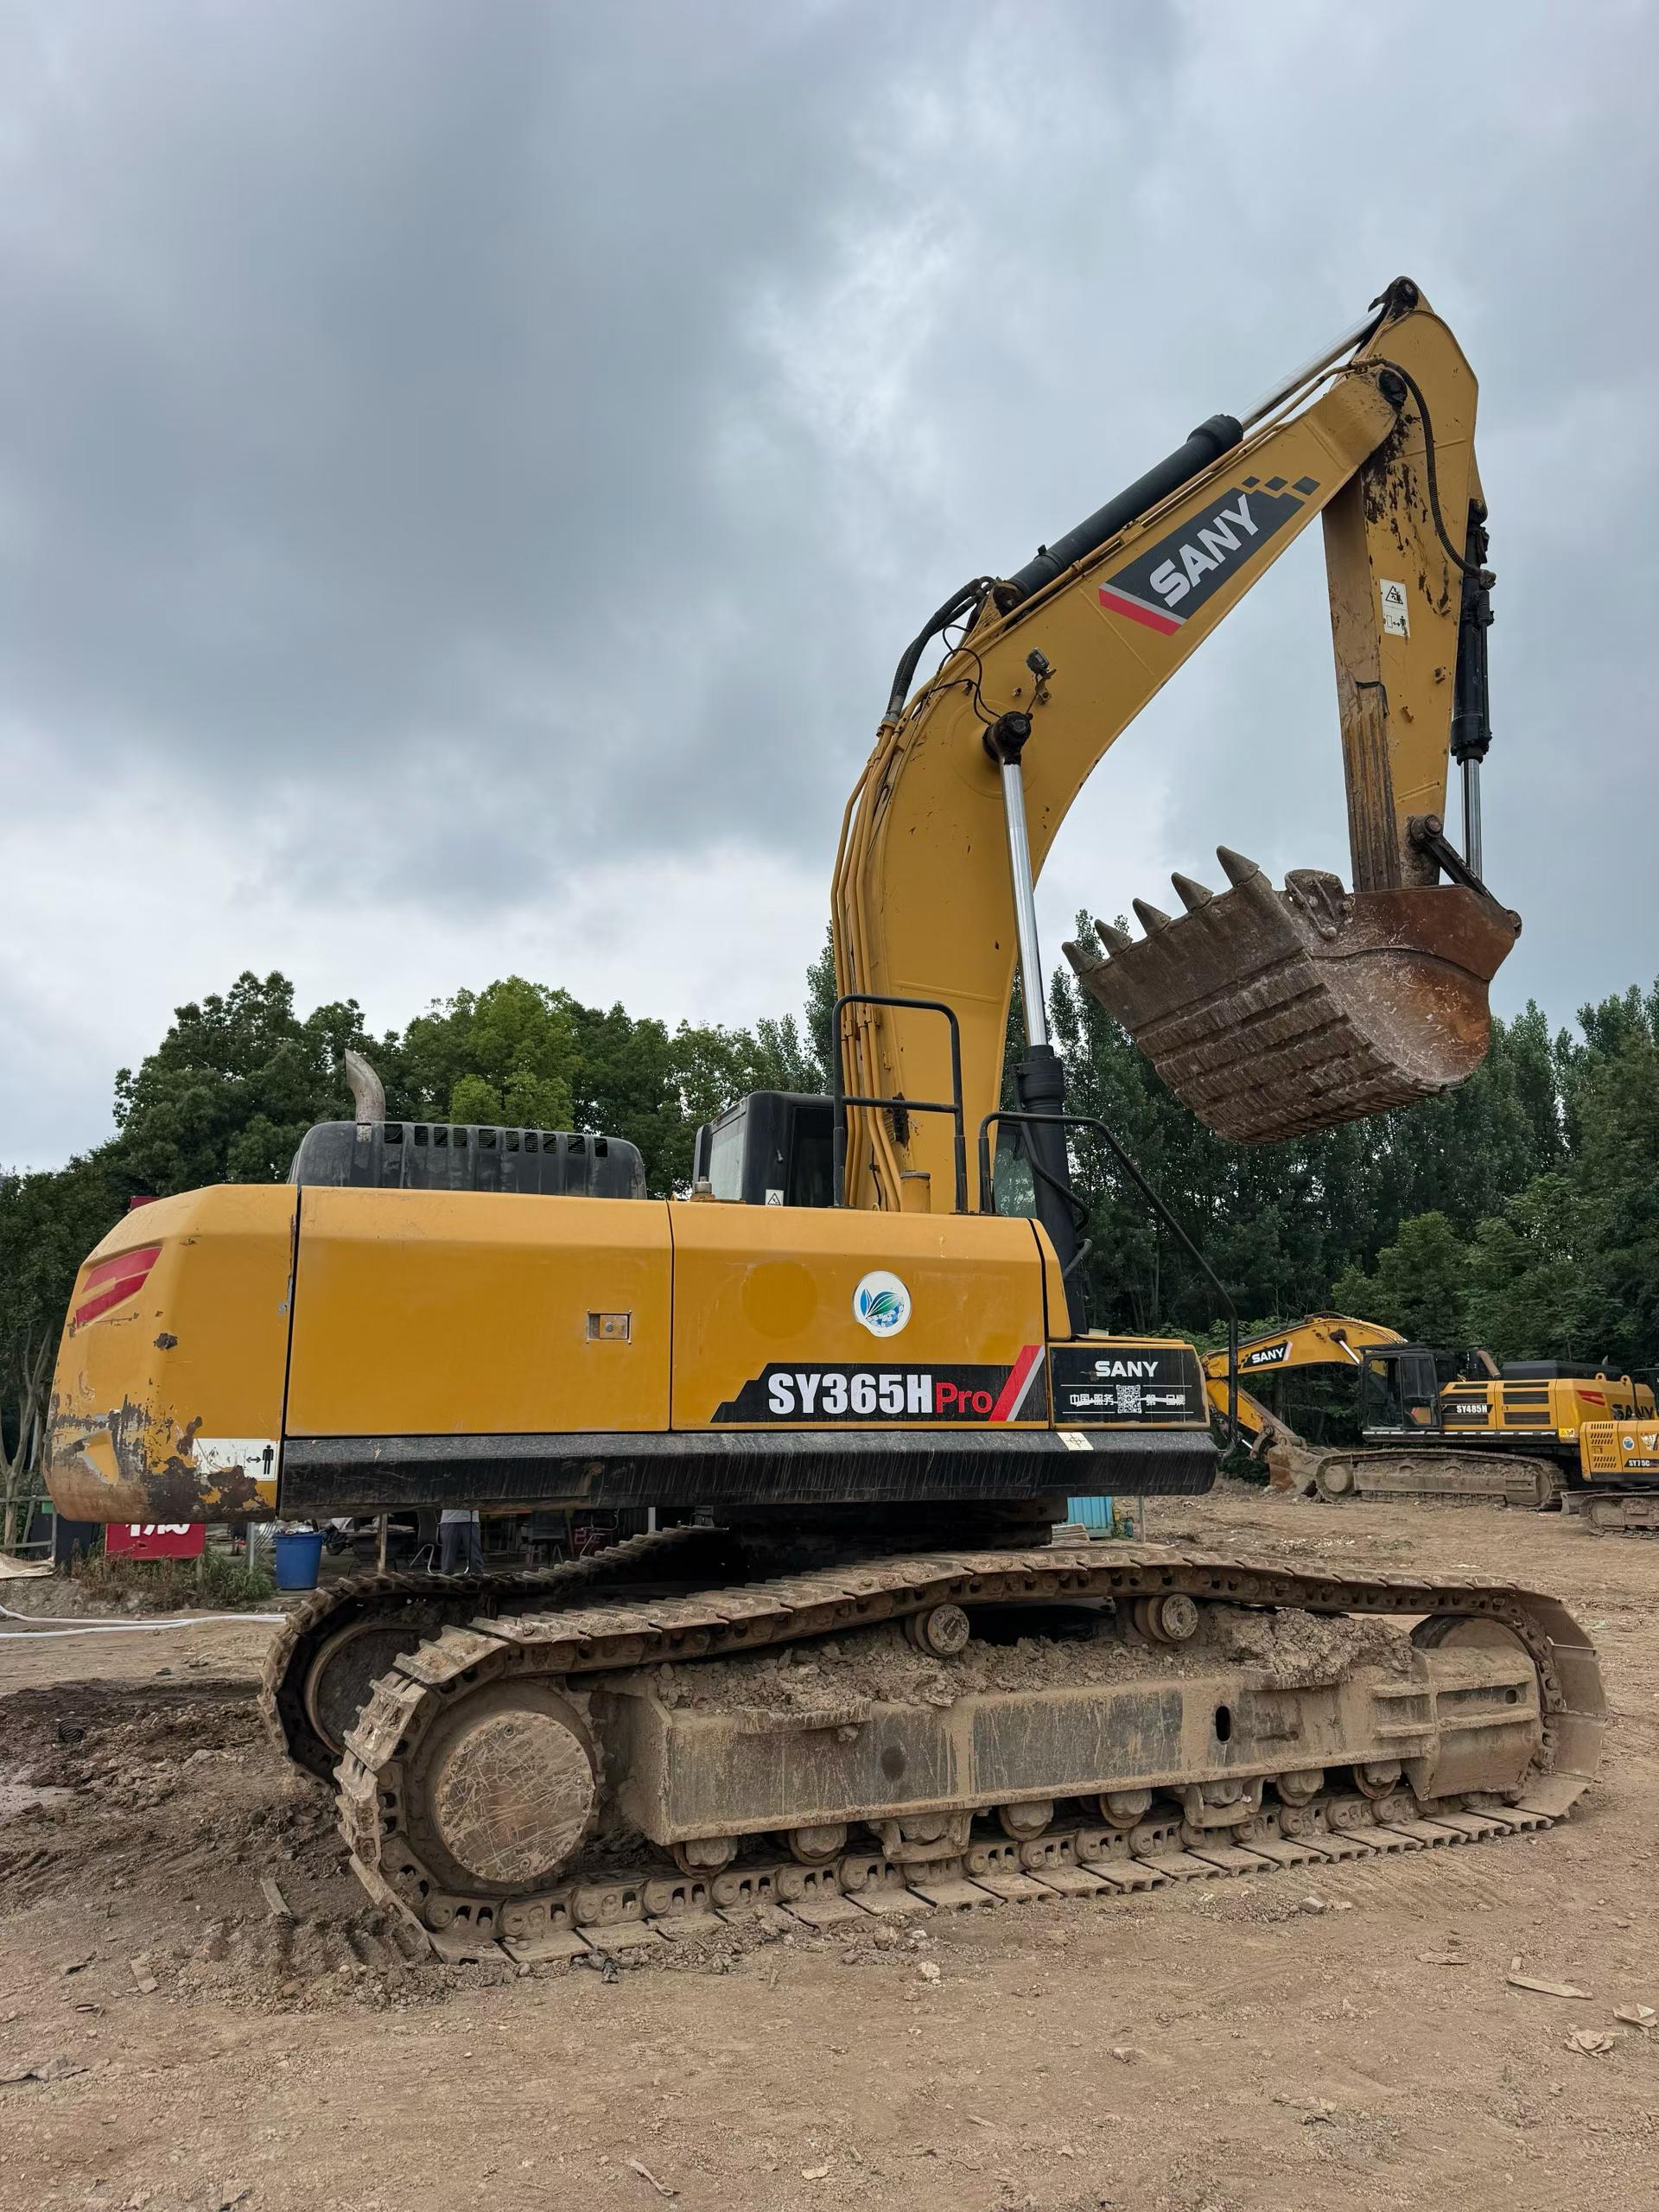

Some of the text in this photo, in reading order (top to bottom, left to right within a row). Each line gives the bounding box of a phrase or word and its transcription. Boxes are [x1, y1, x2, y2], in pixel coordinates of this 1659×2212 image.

[1149, 493, 1259, 607] SANY
[1251, 1347, 1284, 1364] SANY
[1095, 1360, 1159, 1377] SANY
[1456, 1404, 1488, 1414] SY485H
